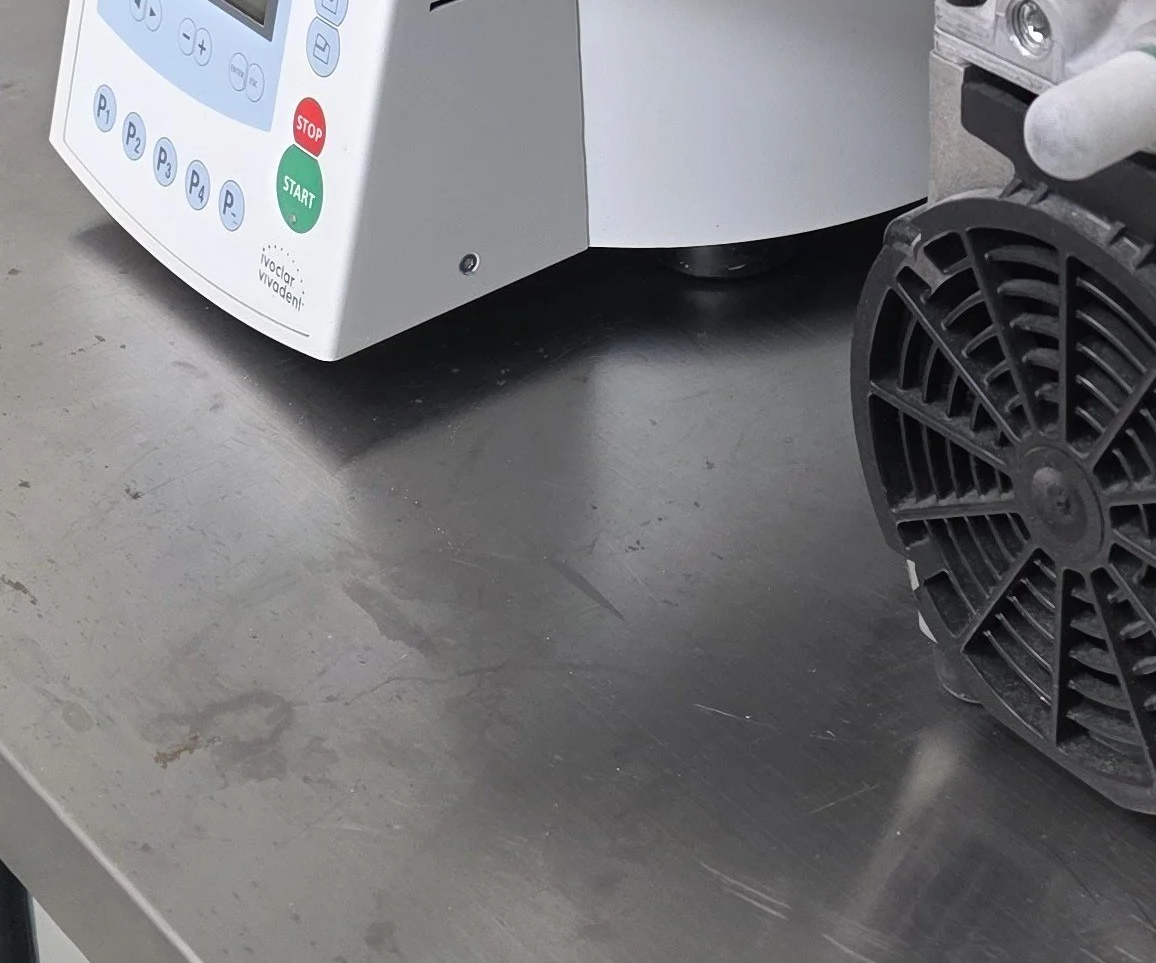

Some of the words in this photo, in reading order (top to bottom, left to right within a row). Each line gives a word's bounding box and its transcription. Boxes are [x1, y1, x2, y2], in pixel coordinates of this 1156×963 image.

[296, 115, 323, 143] STOP
[283, 175, 316, 209] START
[260, 251, 296, 287] ivoclar
